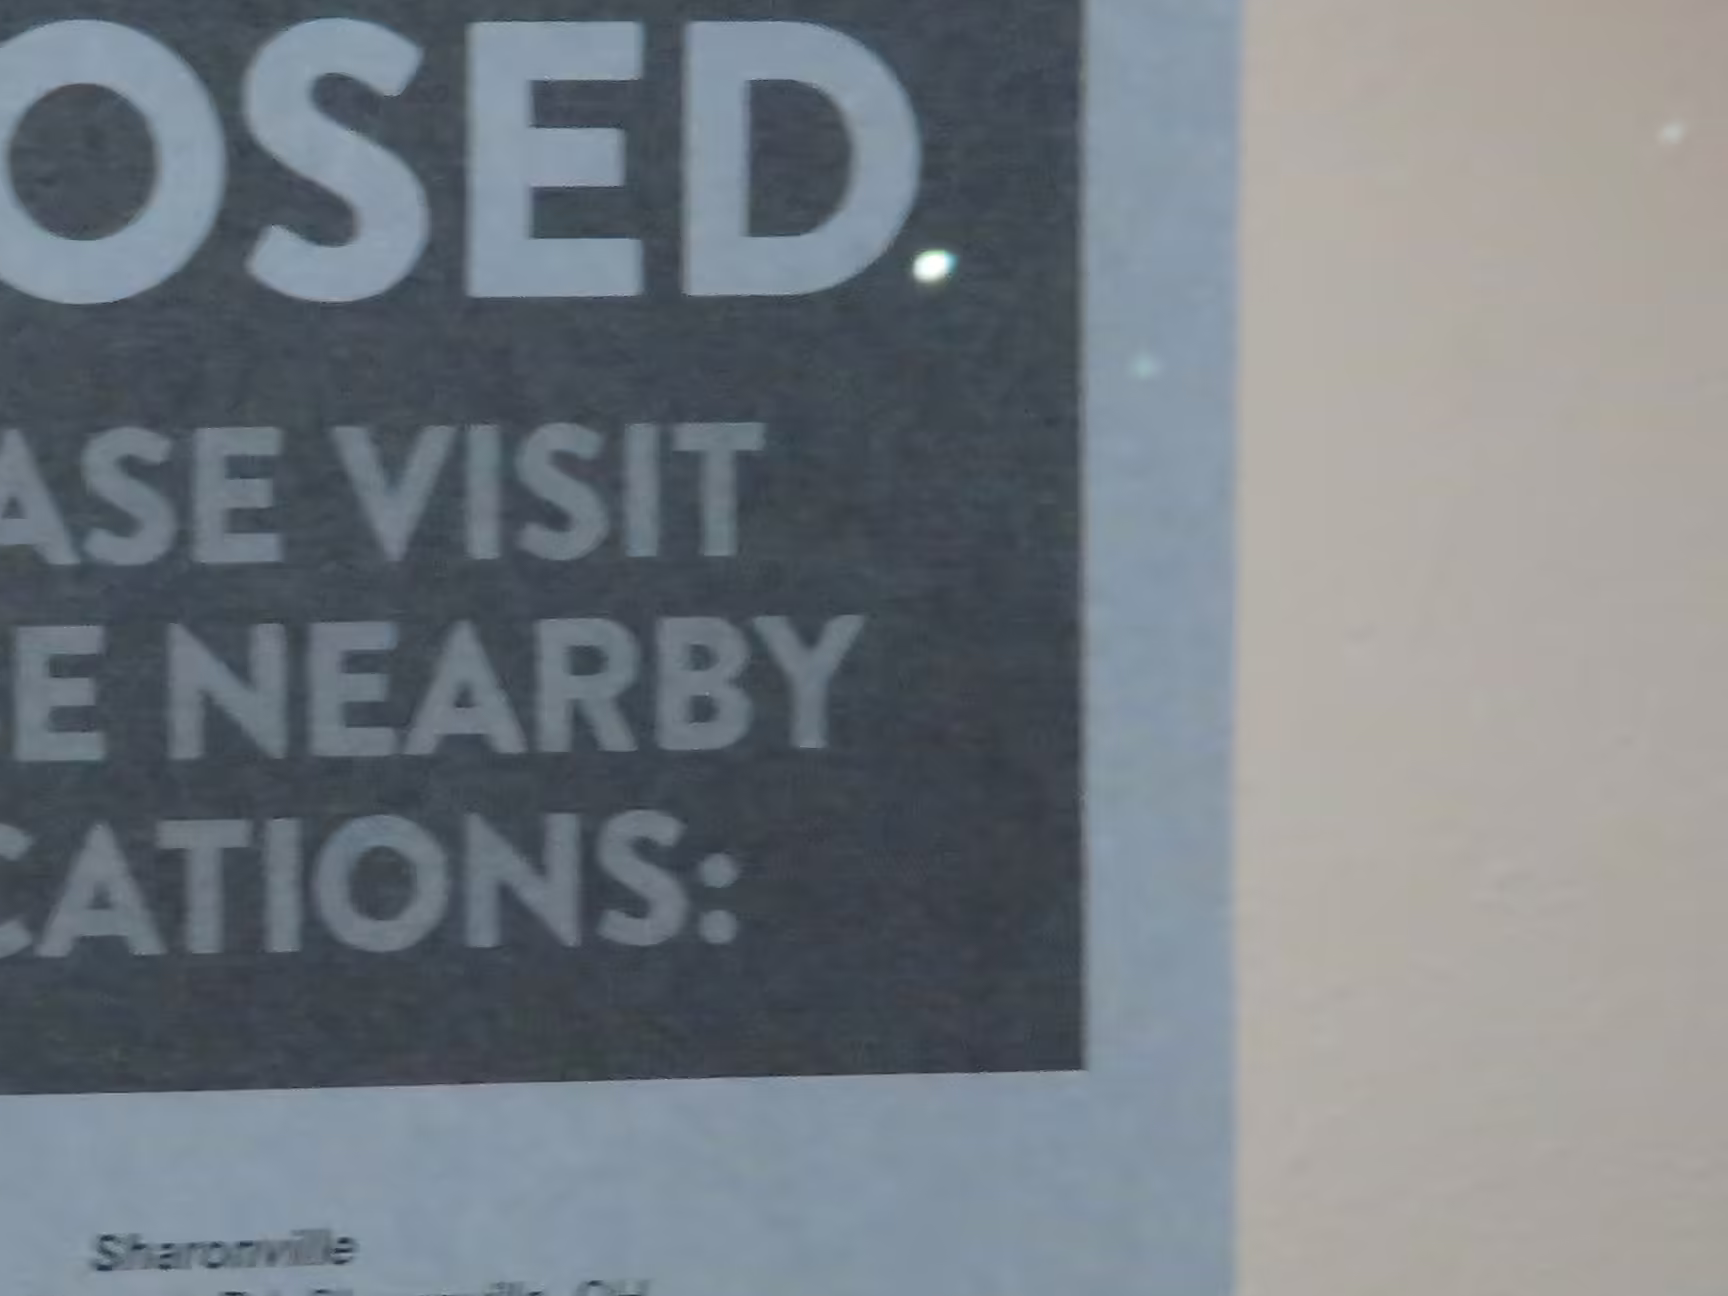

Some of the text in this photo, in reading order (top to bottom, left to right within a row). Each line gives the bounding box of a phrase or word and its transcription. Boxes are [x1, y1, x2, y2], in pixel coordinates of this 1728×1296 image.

[339, 421, 766, 562] VISIT
[166, 613, 867, 761] NEARBY
[92, 1226, 359, 1272] Sharonville
